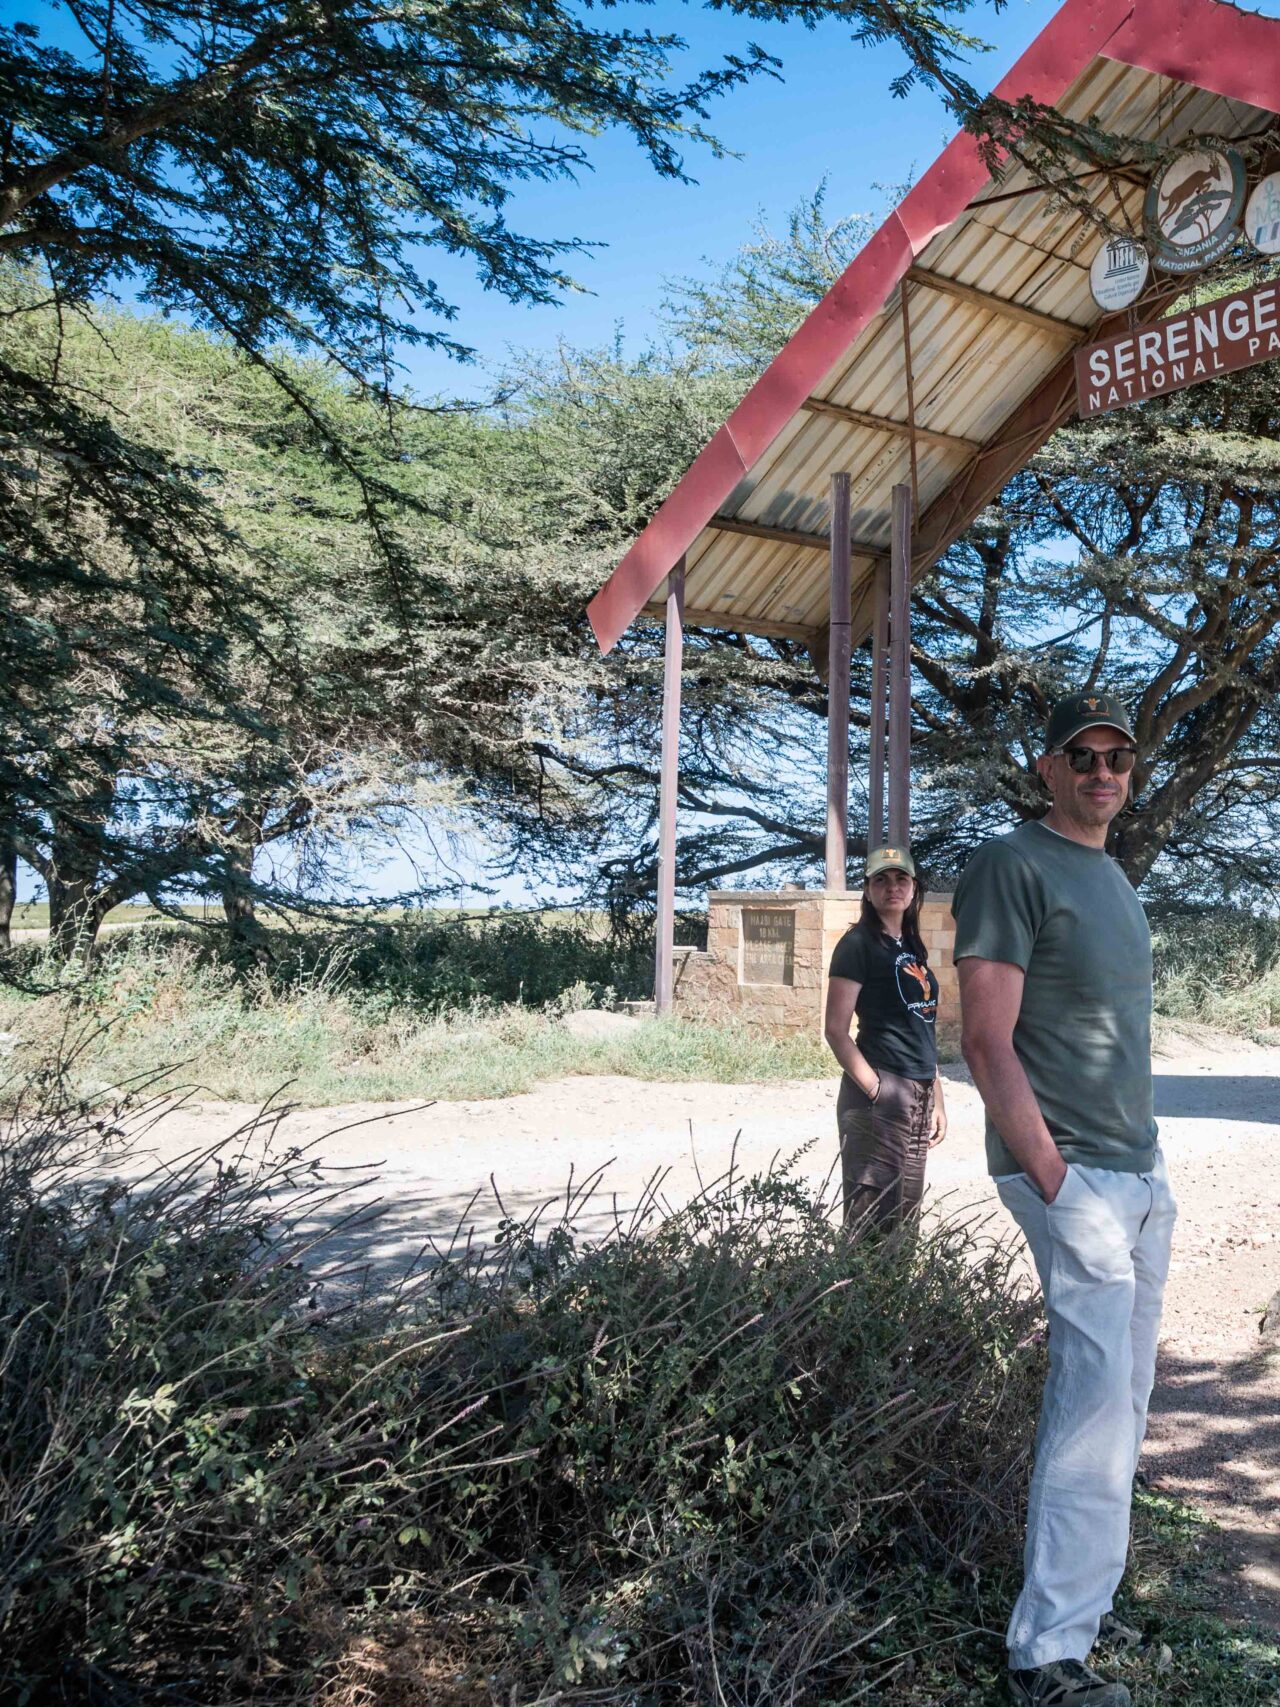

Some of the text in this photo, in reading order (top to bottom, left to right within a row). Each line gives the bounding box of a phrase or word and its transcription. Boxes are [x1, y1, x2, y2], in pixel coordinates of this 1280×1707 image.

[1157, 232, 1235, 271] NATIONAL PARKS
[1088, 352, 1225, 411] NATIONAL
